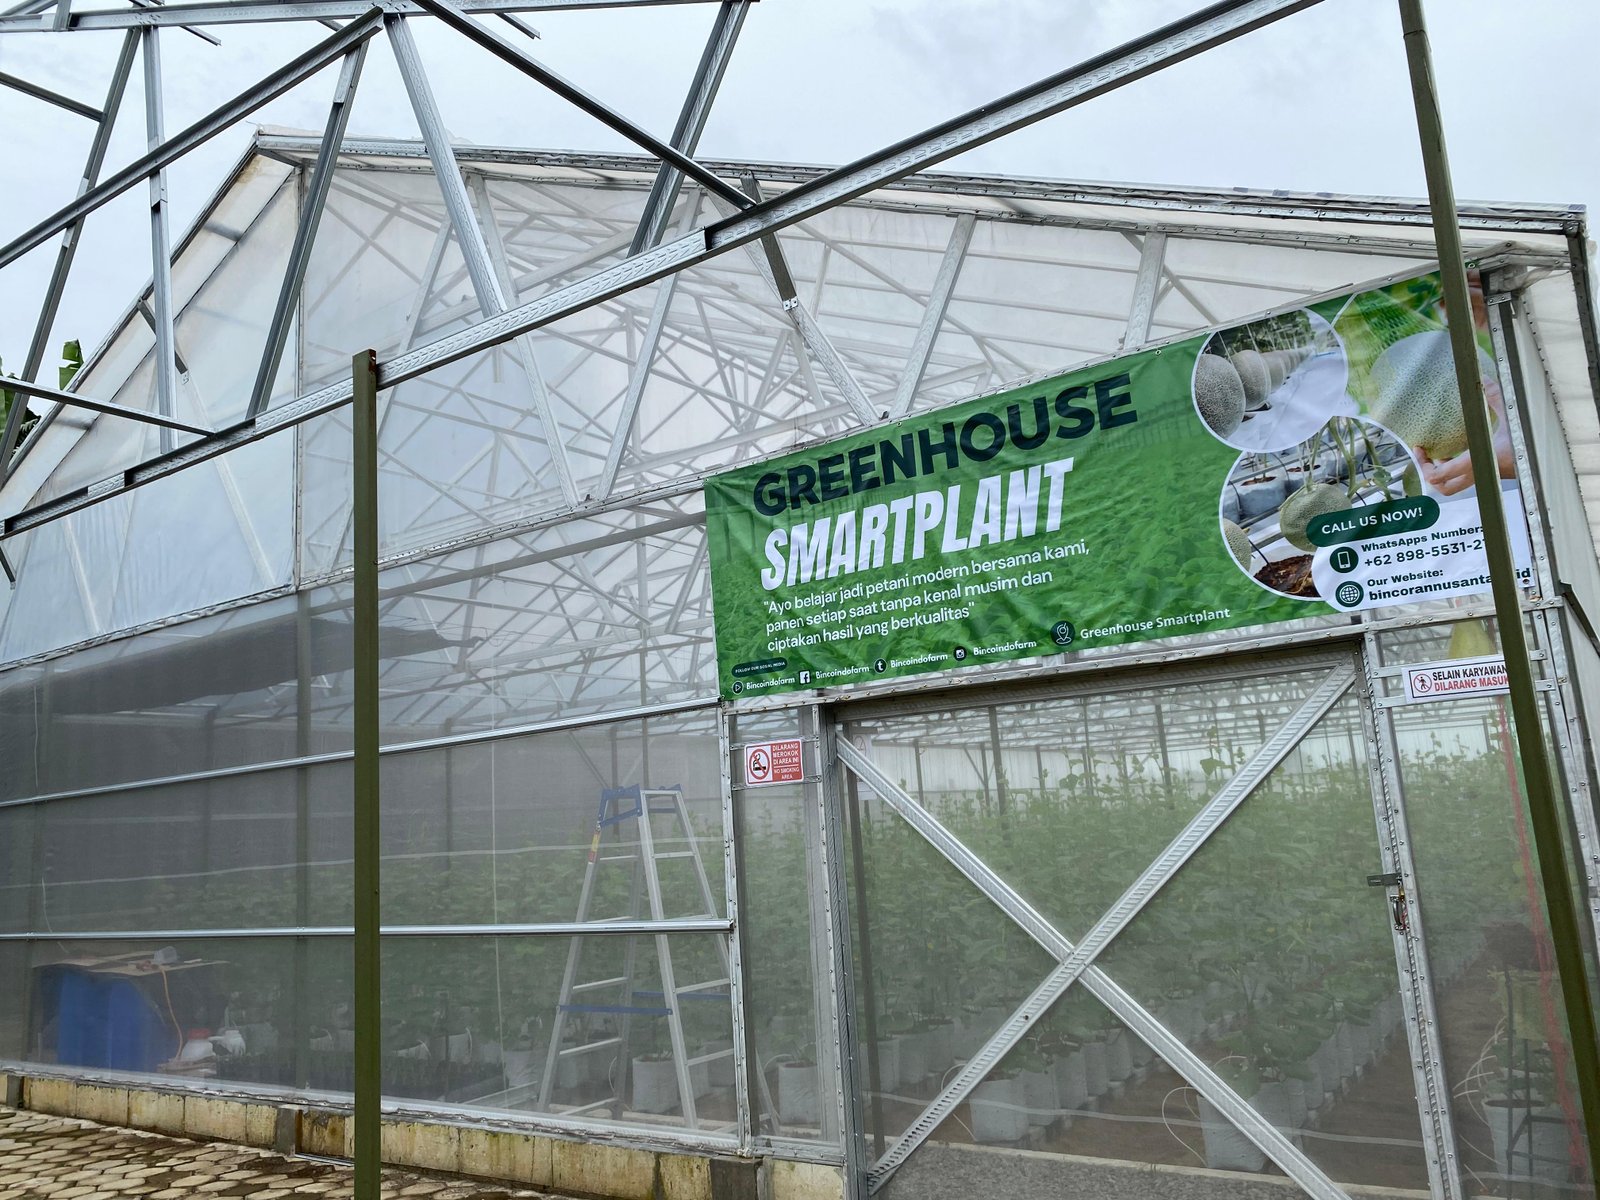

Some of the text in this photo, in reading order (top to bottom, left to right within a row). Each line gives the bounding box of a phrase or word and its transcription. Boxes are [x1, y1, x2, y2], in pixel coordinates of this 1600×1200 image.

[753, 373, 1138, 516] GREENHOUSE
[760, 457, 1075, 591] SMARTPLANT
[1321, 507, 1423, 535] CALL US NOW!
[1361, 524, 1484, 553] WhatsApps Number:
[1364, 538, 1486, 567] +62 898-5531-2
[763, 538, 1089, 616] "Ayo belajar jadi petani modern bersama kami,
[1367, 569, 1444, 587] Our Website:
[766, 571, 1052, 636] panen setiap saat tanpa kenal musim dan
[767, 601, 975, 653] ciptakan hasil yang berkualitas"
[1080, 608, 1231, 640] Greenhouse Smartplant
[973, 640, 1037, 656] Bincoindofarm
[890, 653, 949, 668] Bincoindofarm
[746, 677, 795, 690] Bincoindofarm
[815, 665, 870, 680] Bincoindofarm
[1432, 669, 1461, 681] SELAIN
[1434, 678, 1477, 691] DILARANG
[772, 743, 799, 751] DILARANG
[773, 750, 799, 758] MEROKOK
